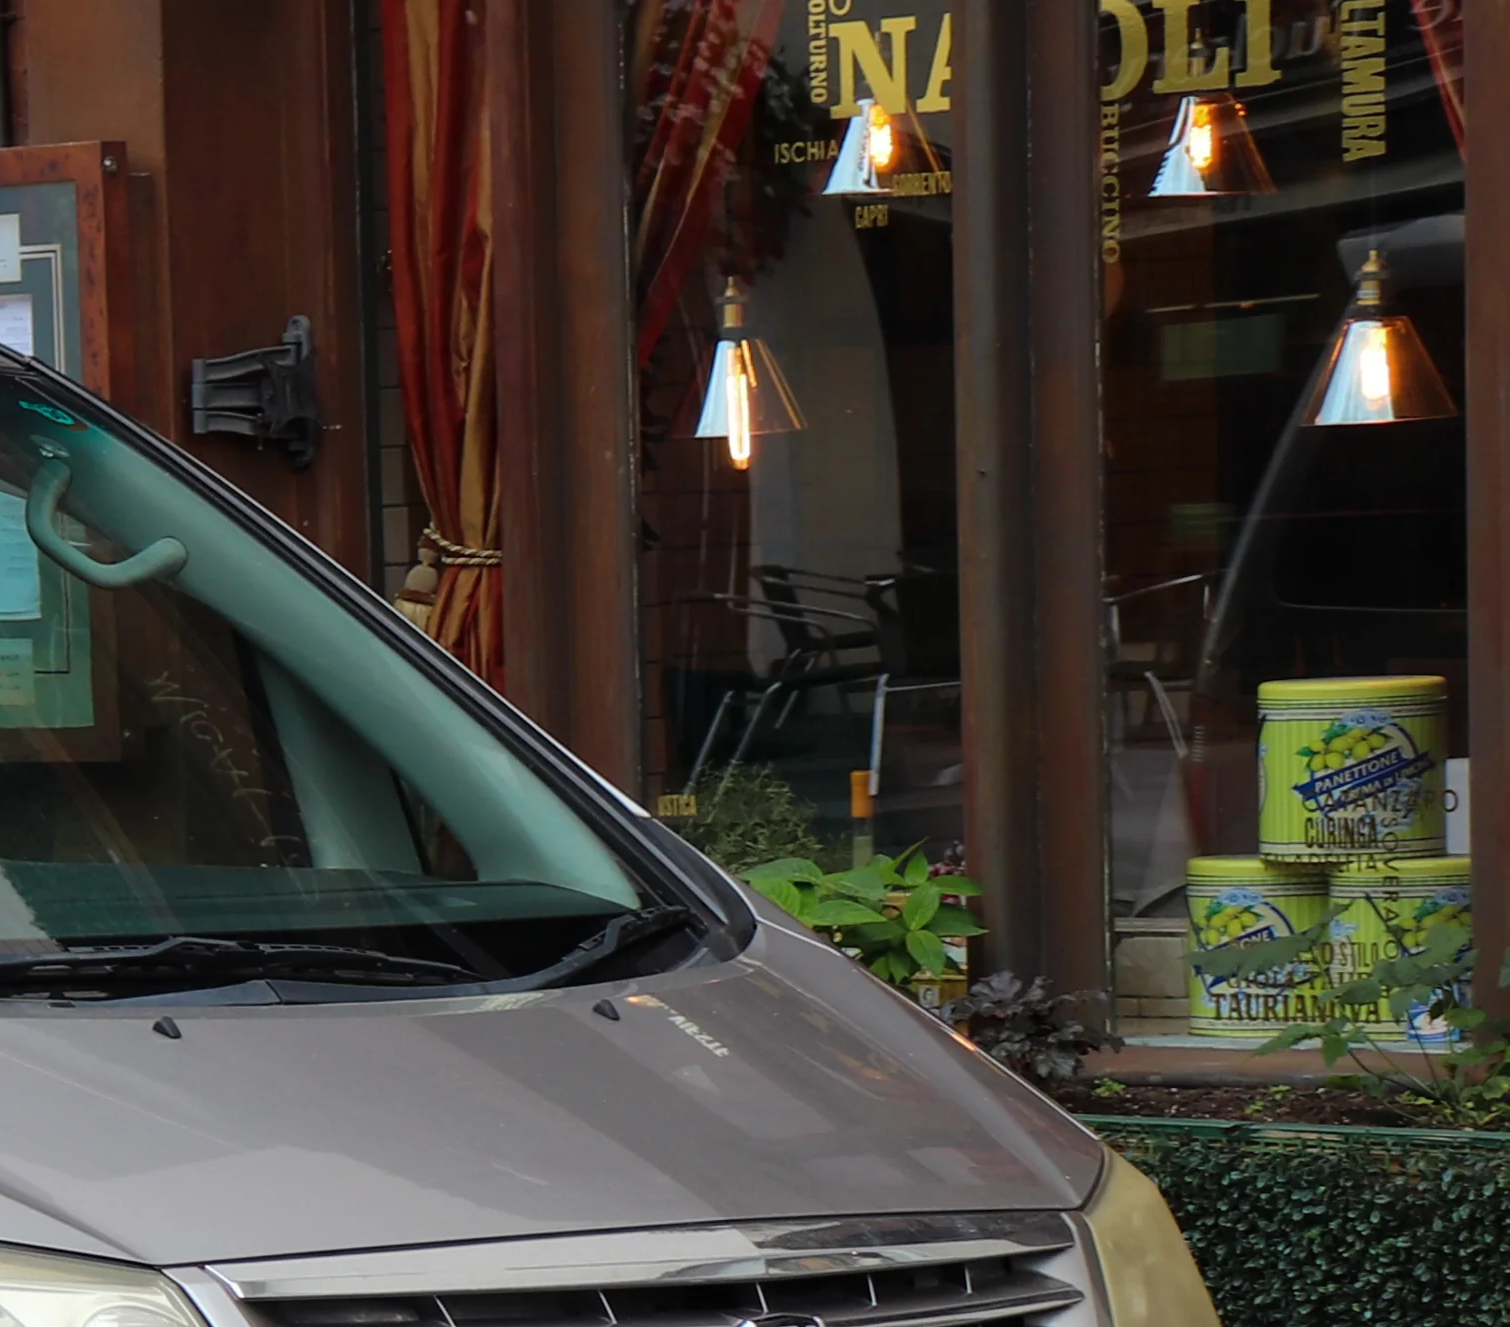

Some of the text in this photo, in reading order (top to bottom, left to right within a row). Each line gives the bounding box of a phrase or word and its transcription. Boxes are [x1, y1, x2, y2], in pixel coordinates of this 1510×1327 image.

[774, 139, 839, 164] ISCHIA
[1100, 102, 1121, 264] BUCCINO
[1314, 751, 1399, 793] PANETTONE
[1304, 816, 1379, 849] CURINGA
[1381, 815, 1400, 960] SOVERAO
[1210, 992, 1380, 1023] TAURIANVA
